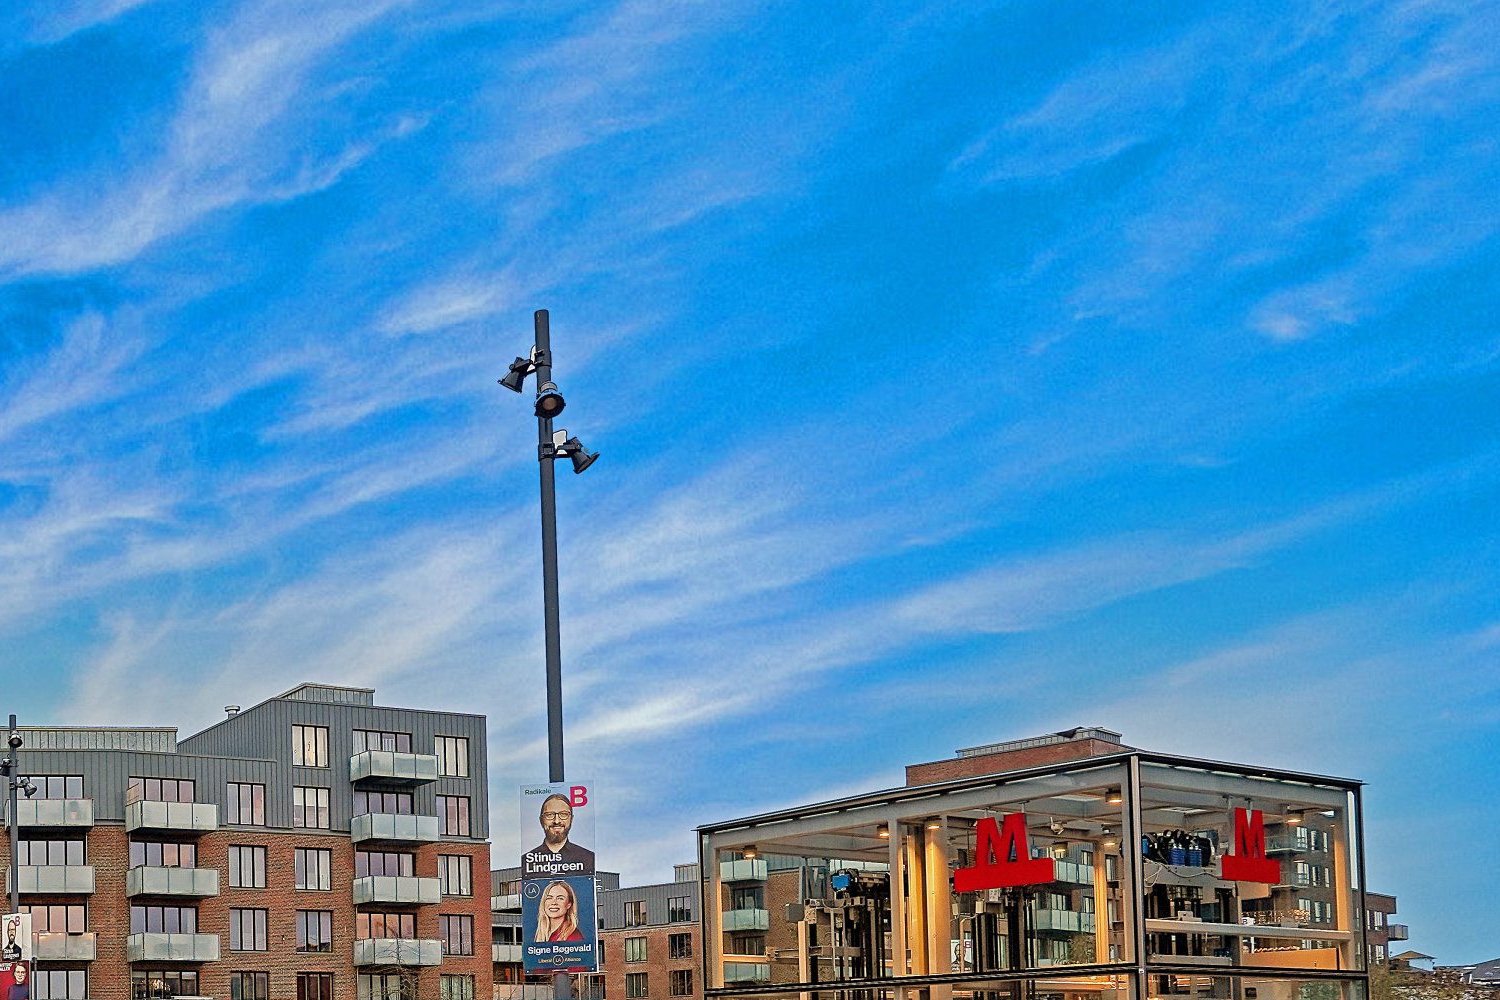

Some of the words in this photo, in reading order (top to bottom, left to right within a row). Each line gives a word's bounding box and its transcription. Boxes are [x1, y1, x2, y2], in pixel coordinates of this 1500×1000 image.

[569, 785, 588, 807] B
[975, 812, 1030, 866] M
[1234, 807, 1266, 858] M
[525, 852, 562, 863] Stinus
[526, 861, 584, 875] Lindgreen
[527, 946, 551, 956] Signe
[552, 944, 592, 955] Bøgevald
